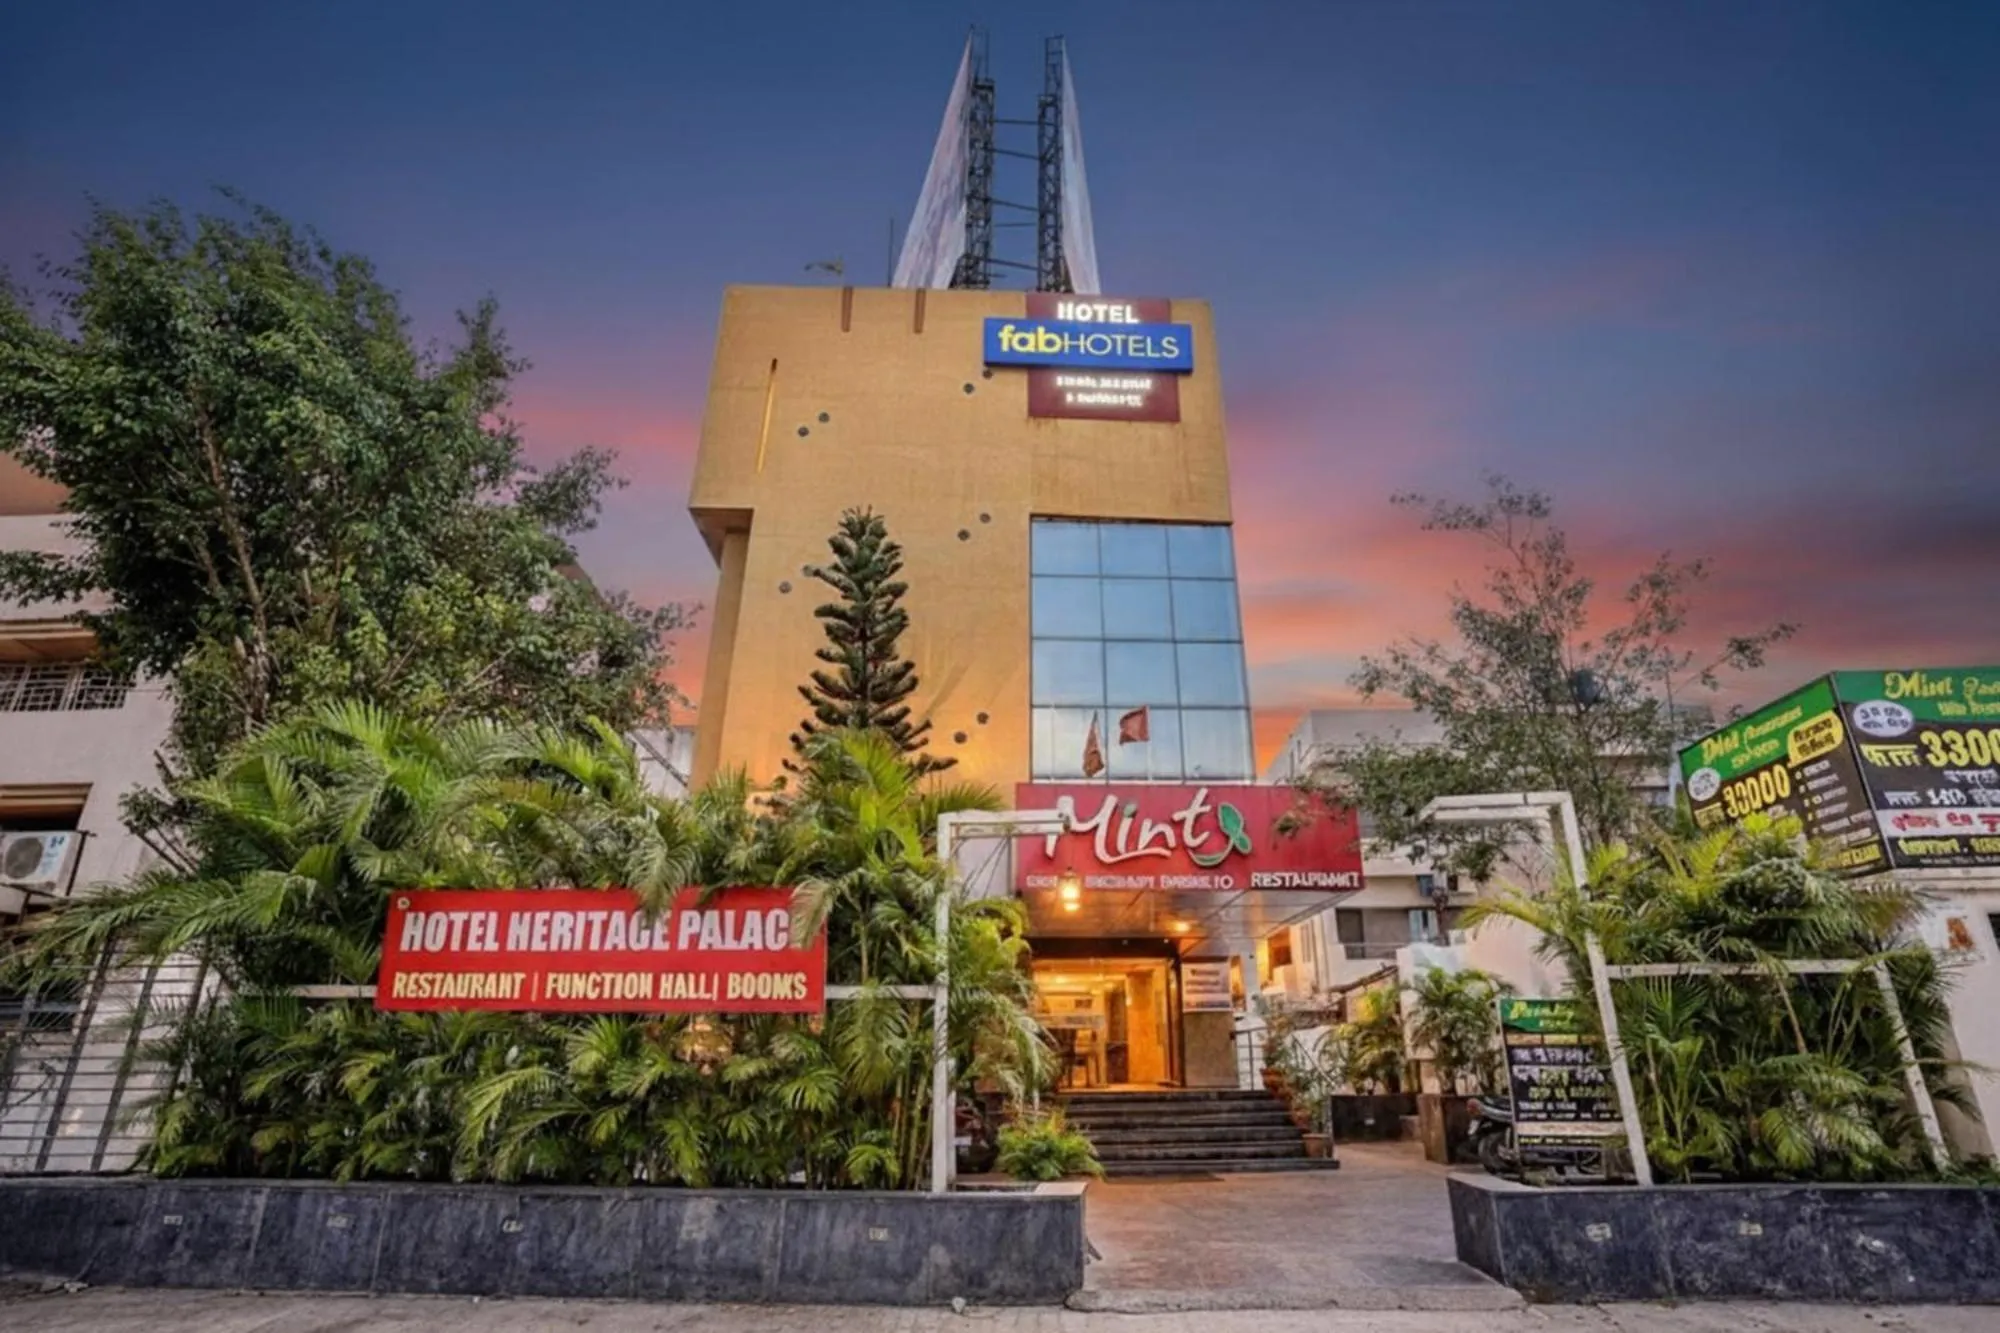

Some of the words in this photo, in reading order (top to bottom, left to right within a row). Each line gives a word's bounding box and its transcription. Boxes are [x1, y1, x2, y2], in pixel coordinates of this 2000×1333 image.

[1057, 303, 1139, 323] HOTEL
[998, 325, 1180, 358] fabHOTELS
[1046, 787, 1212, 864] Mint
[400, 911, 499, 952] HOTEL
[678, 908, 810, 951] PALAC
[392, 971, 526, 999] RESTAURANT
[545, 971, 653, 1000] FUNCTION
